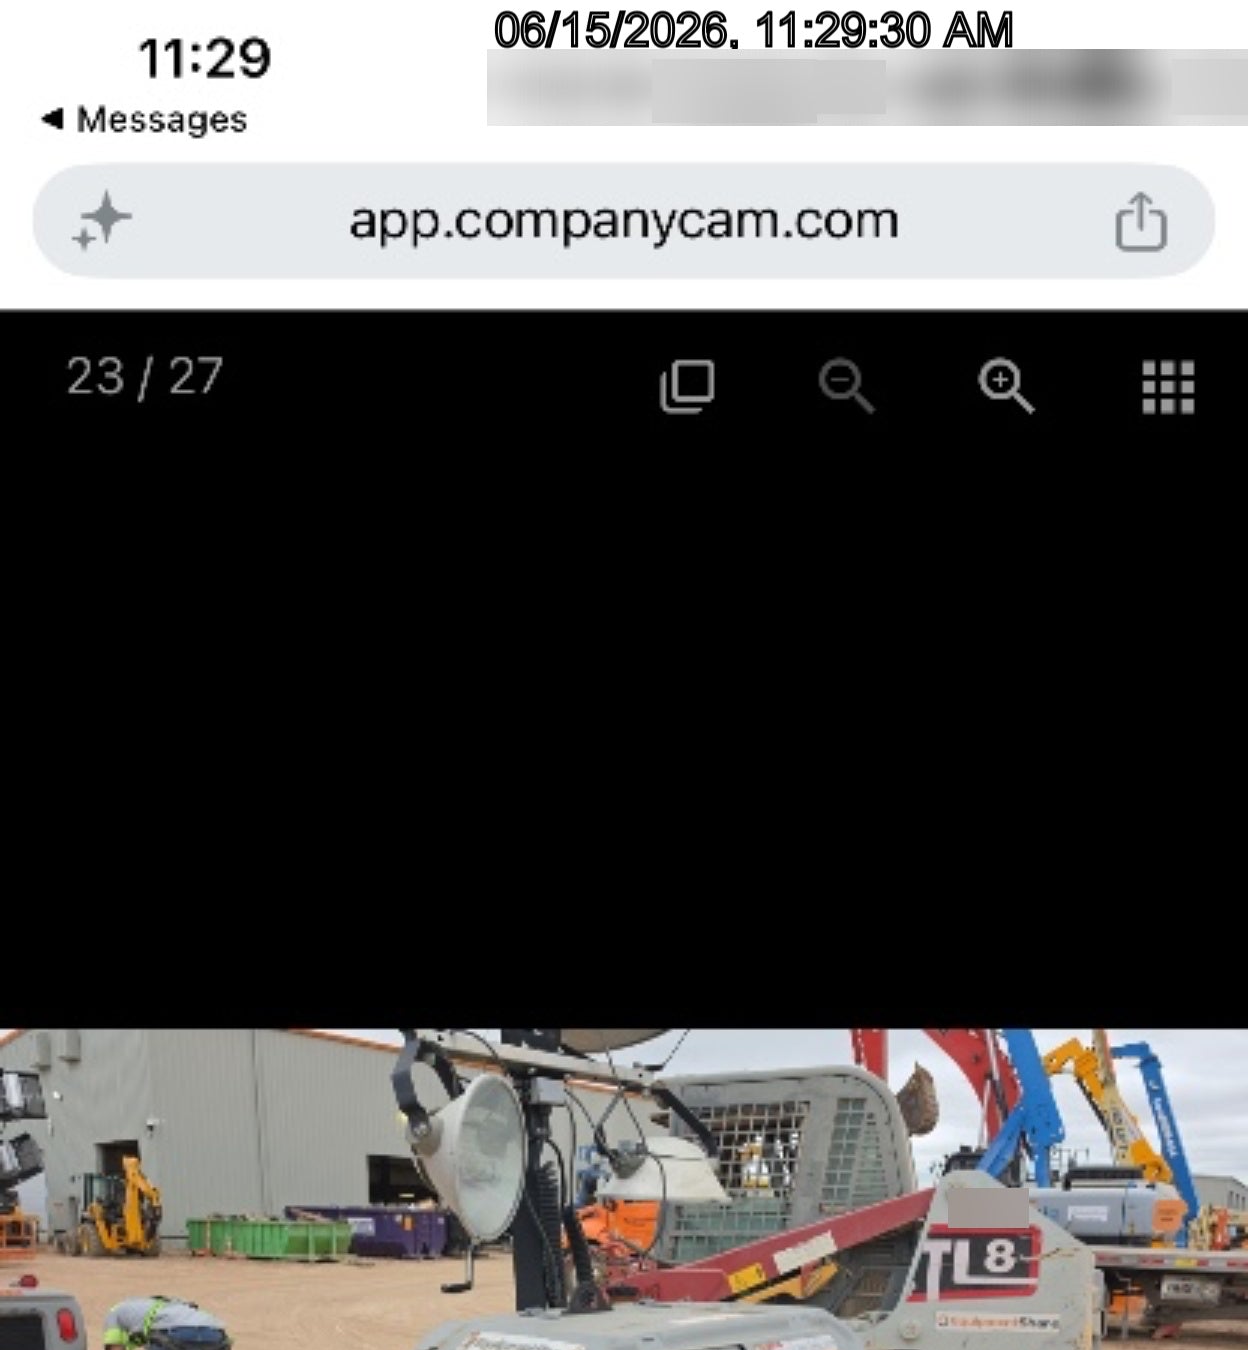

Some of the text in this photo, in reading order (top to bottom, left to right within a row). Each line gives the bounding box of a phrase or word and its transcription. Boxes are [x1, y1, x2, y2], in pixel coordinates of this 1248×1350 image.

[139, 37, 271, 79] 11:29
[77, 105, 248, 139] Messages
[350, 207, 899, 250] app.companycam.com
[67, 355, 125, 403] 23
[170, 355, 223, 403] 27
[921, 1238, 1039, 1301] TL8
